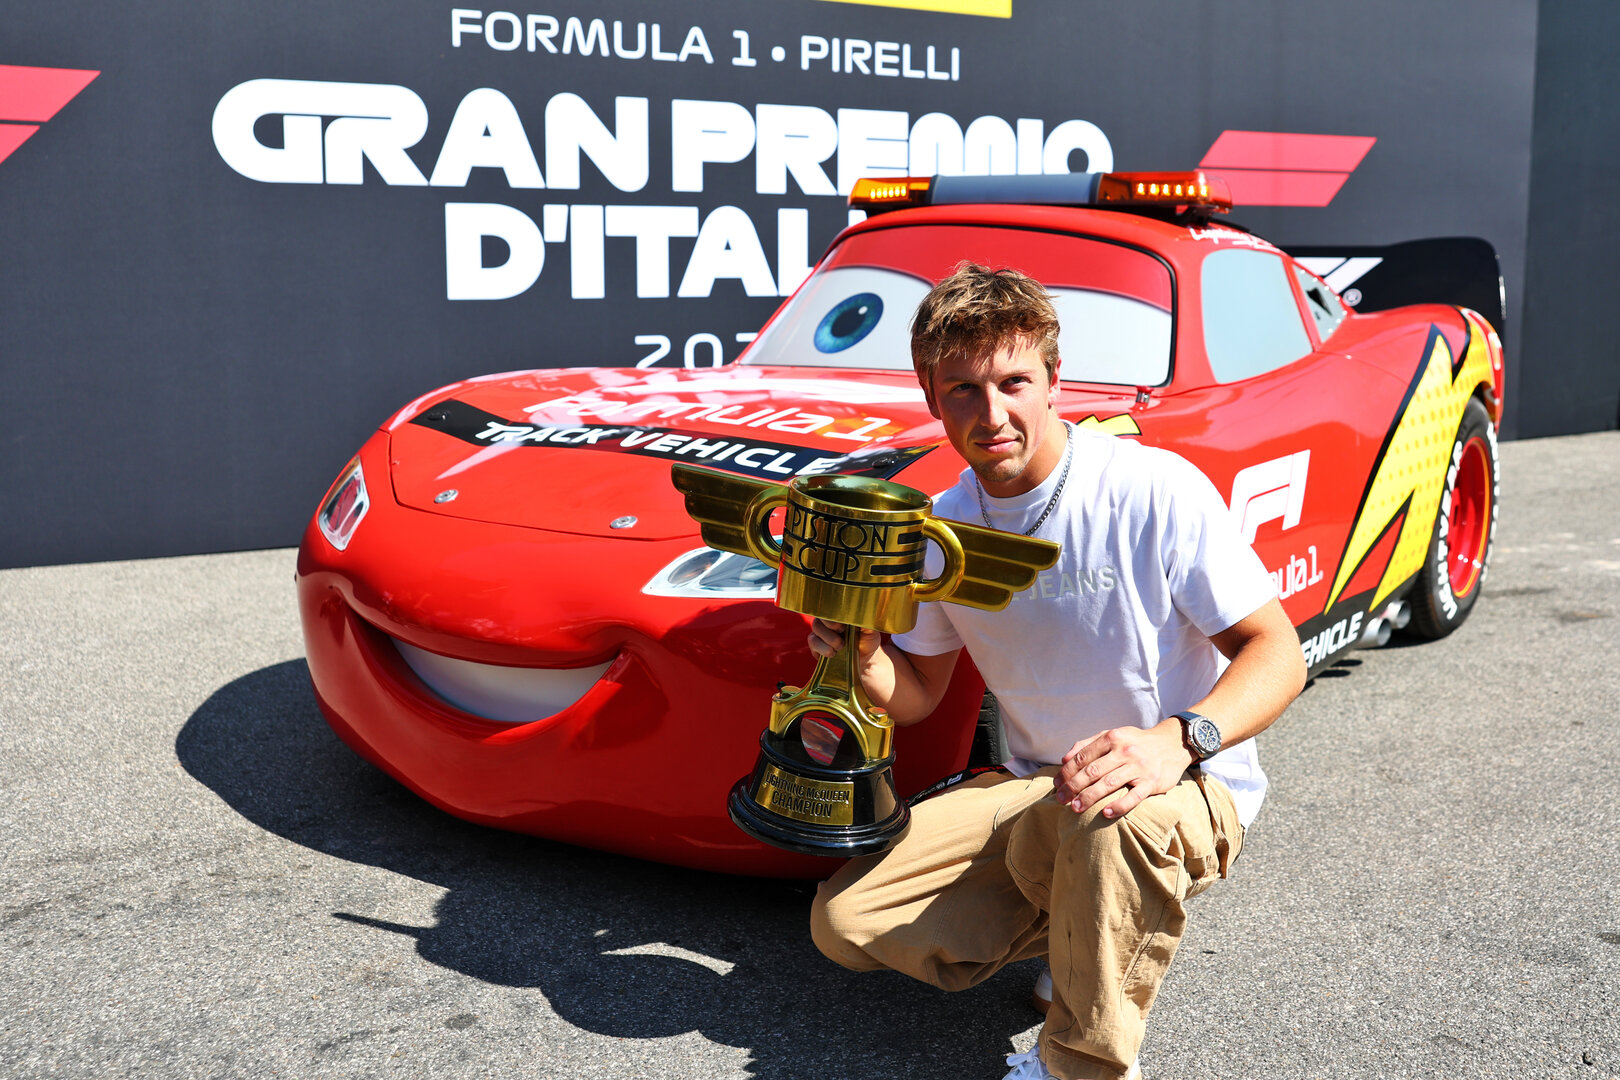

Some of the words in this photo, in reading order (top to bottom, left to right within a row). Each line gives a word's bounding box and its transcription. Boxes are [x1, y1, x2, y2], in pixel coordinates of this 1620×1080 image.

[451, 8, 714, 64] FORMULA
[731, 29, 757, 67] 1
[800, 35, 960, 82] PIRELLI
[211, 78, 649, 193] GRAN
[671, 98, 1114, 196] PREMIO
[445, 202, 868, 300] D'ITAL
[634, 332, 759, 369] 20
[475, 421, 620, 444] TRACK
[619, 430, 846, 476] VEHICLE
[792, 506, 889, 553] PISTON
[798, 544, 860, 582] CUP
[1029, 565, 1117, 600] JEANS
[1301, 610, 1364, 668] EHICLE
[765, 771, 804, 797] LIGHTNING
[771, 790, 832, 818] CHAMPION
